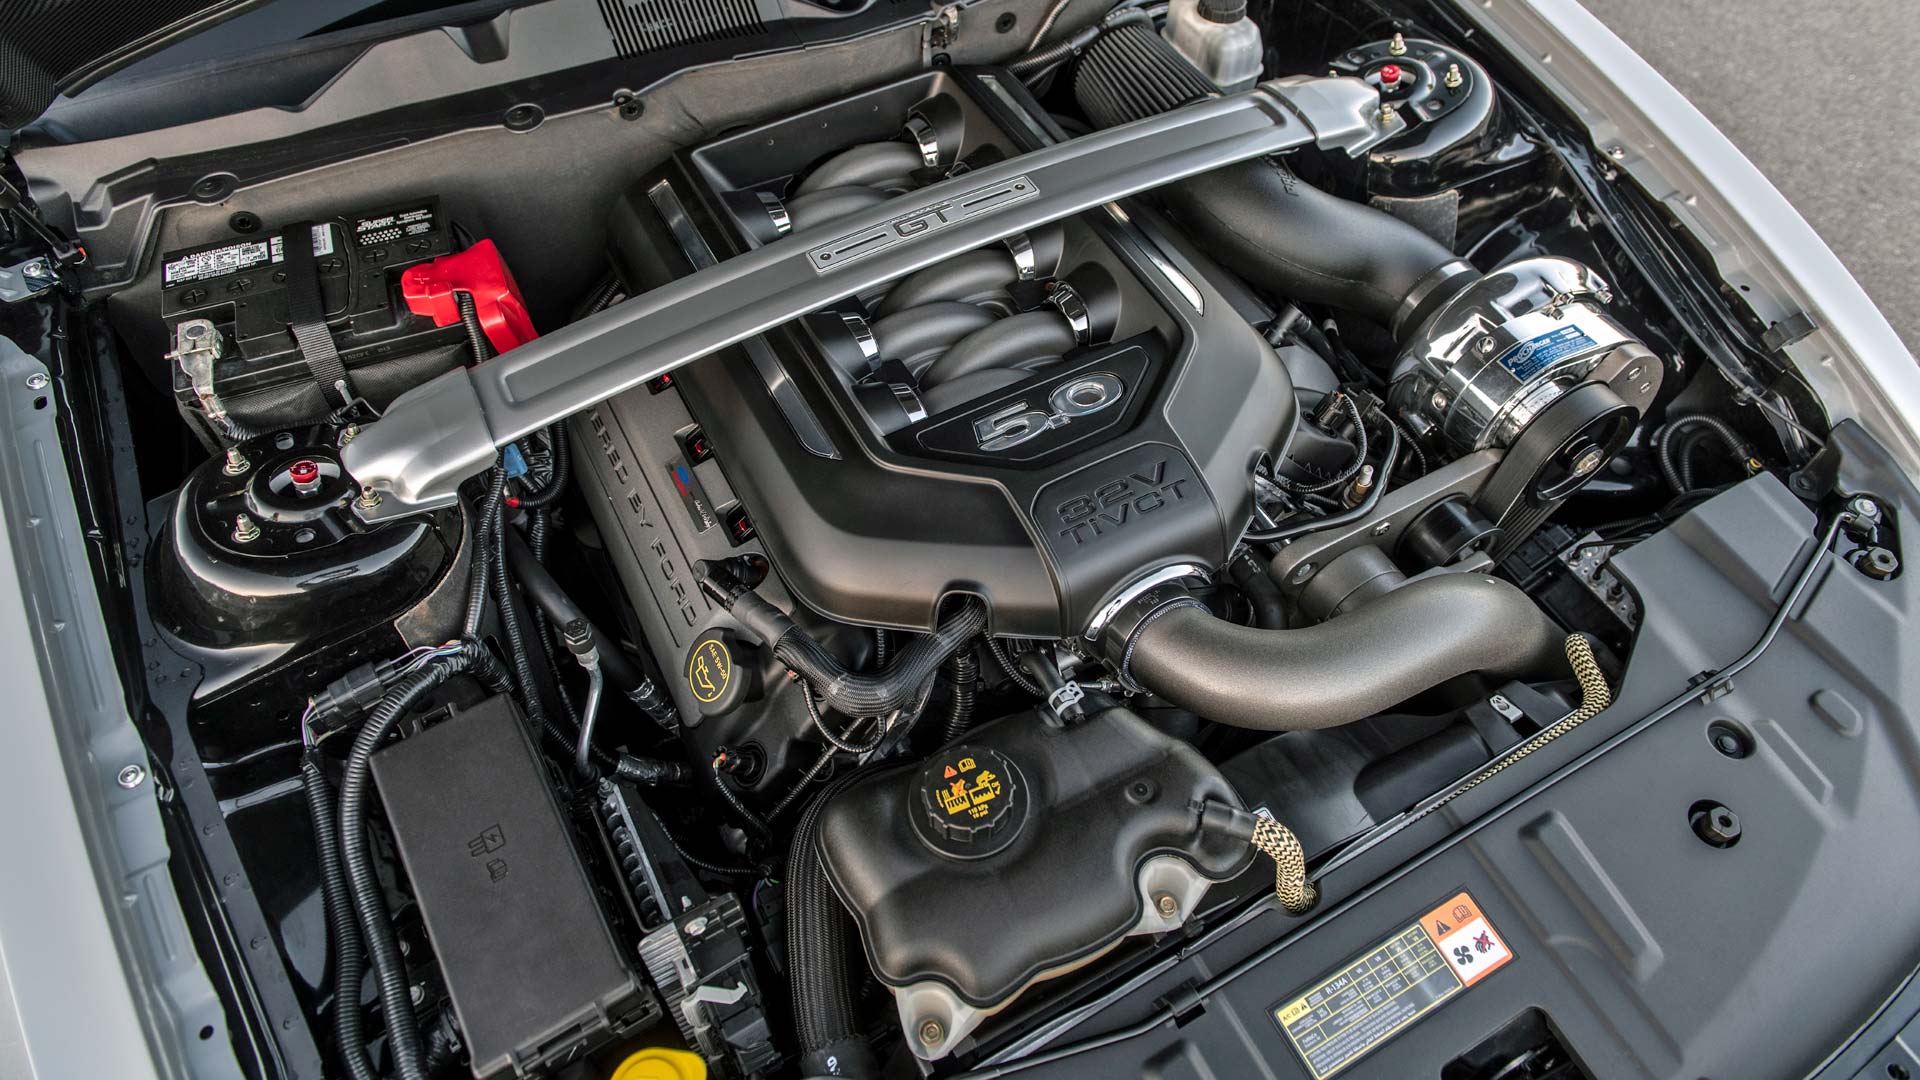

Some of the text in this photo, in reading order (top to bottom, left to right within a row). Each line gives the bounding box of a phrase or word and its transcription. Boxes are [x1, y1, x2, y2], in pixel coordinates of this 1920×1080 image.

[893, 204, 953, 237] GT
[971, 371, 1125, 451] 5.0
[1056, 461, 1167, 524] 32V
[587, 408, 698, 628] ERED BY FORD
[709, 643, 719, 658] SAE
[1325, 977, 1349, 995] R-134A
